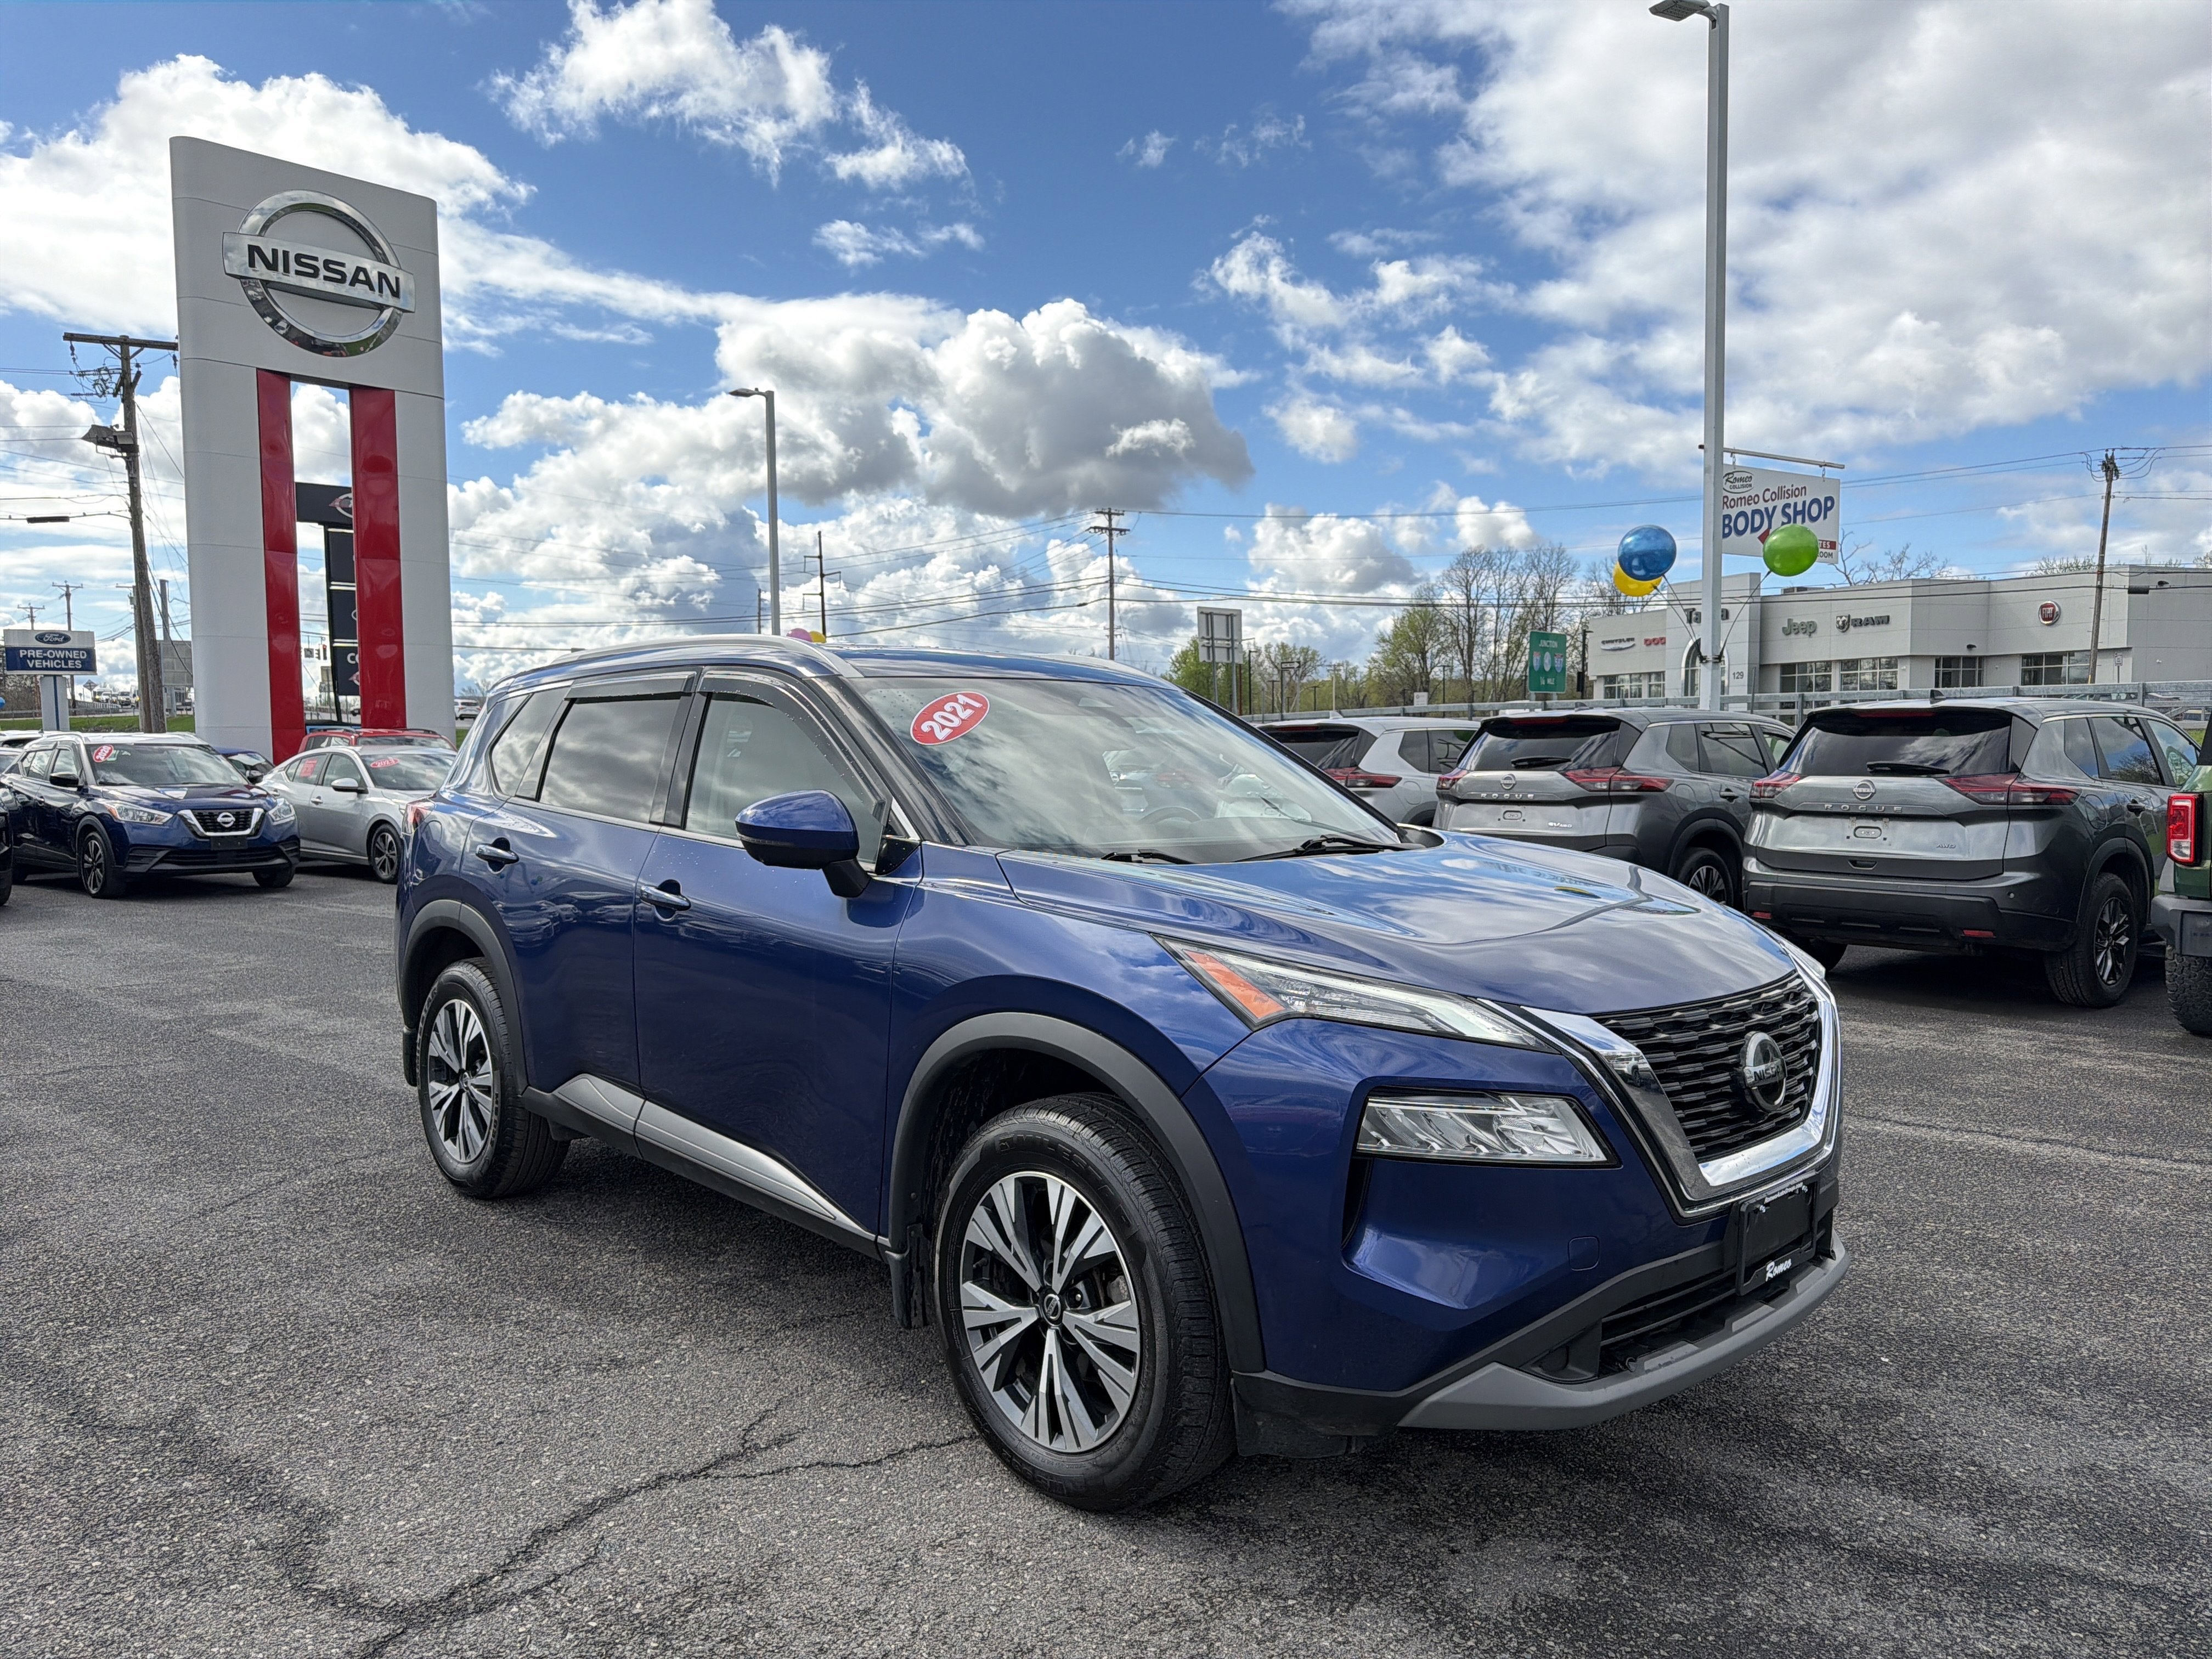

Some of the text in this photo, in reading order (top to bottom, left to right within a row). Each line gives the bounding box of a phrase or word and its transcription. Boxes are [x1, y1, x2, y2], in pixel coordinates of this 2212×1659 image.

[247, 244, 401, 299] NISSAN
[1723, 472, 1753, 486] Romeo
[1722, 484, 1807, 510] Romeo Collision
[1722, 496, 1835, 539] BODY SHOP
[2042, 607, 2054, 618] FIAT
[1782, 618, 1817, 637] Jeep
[1851, 615, 1890, 627] RAM
[43, 633, 65, 642] Ford
[19, 650, 87, 659] PRE-OWNED
[26, 659, 82, 669] VEHICLES
[1732, 671, 1744, 680] 129
[921, 694, 983, 741] 2021
[95, 745, 112, 761] 2020
[1824, 804, 1903, 813] ROGUE
[1753, 1064, 1782, 1081] NISSA
[1765, 1259, 1792, 1282] Romeo
